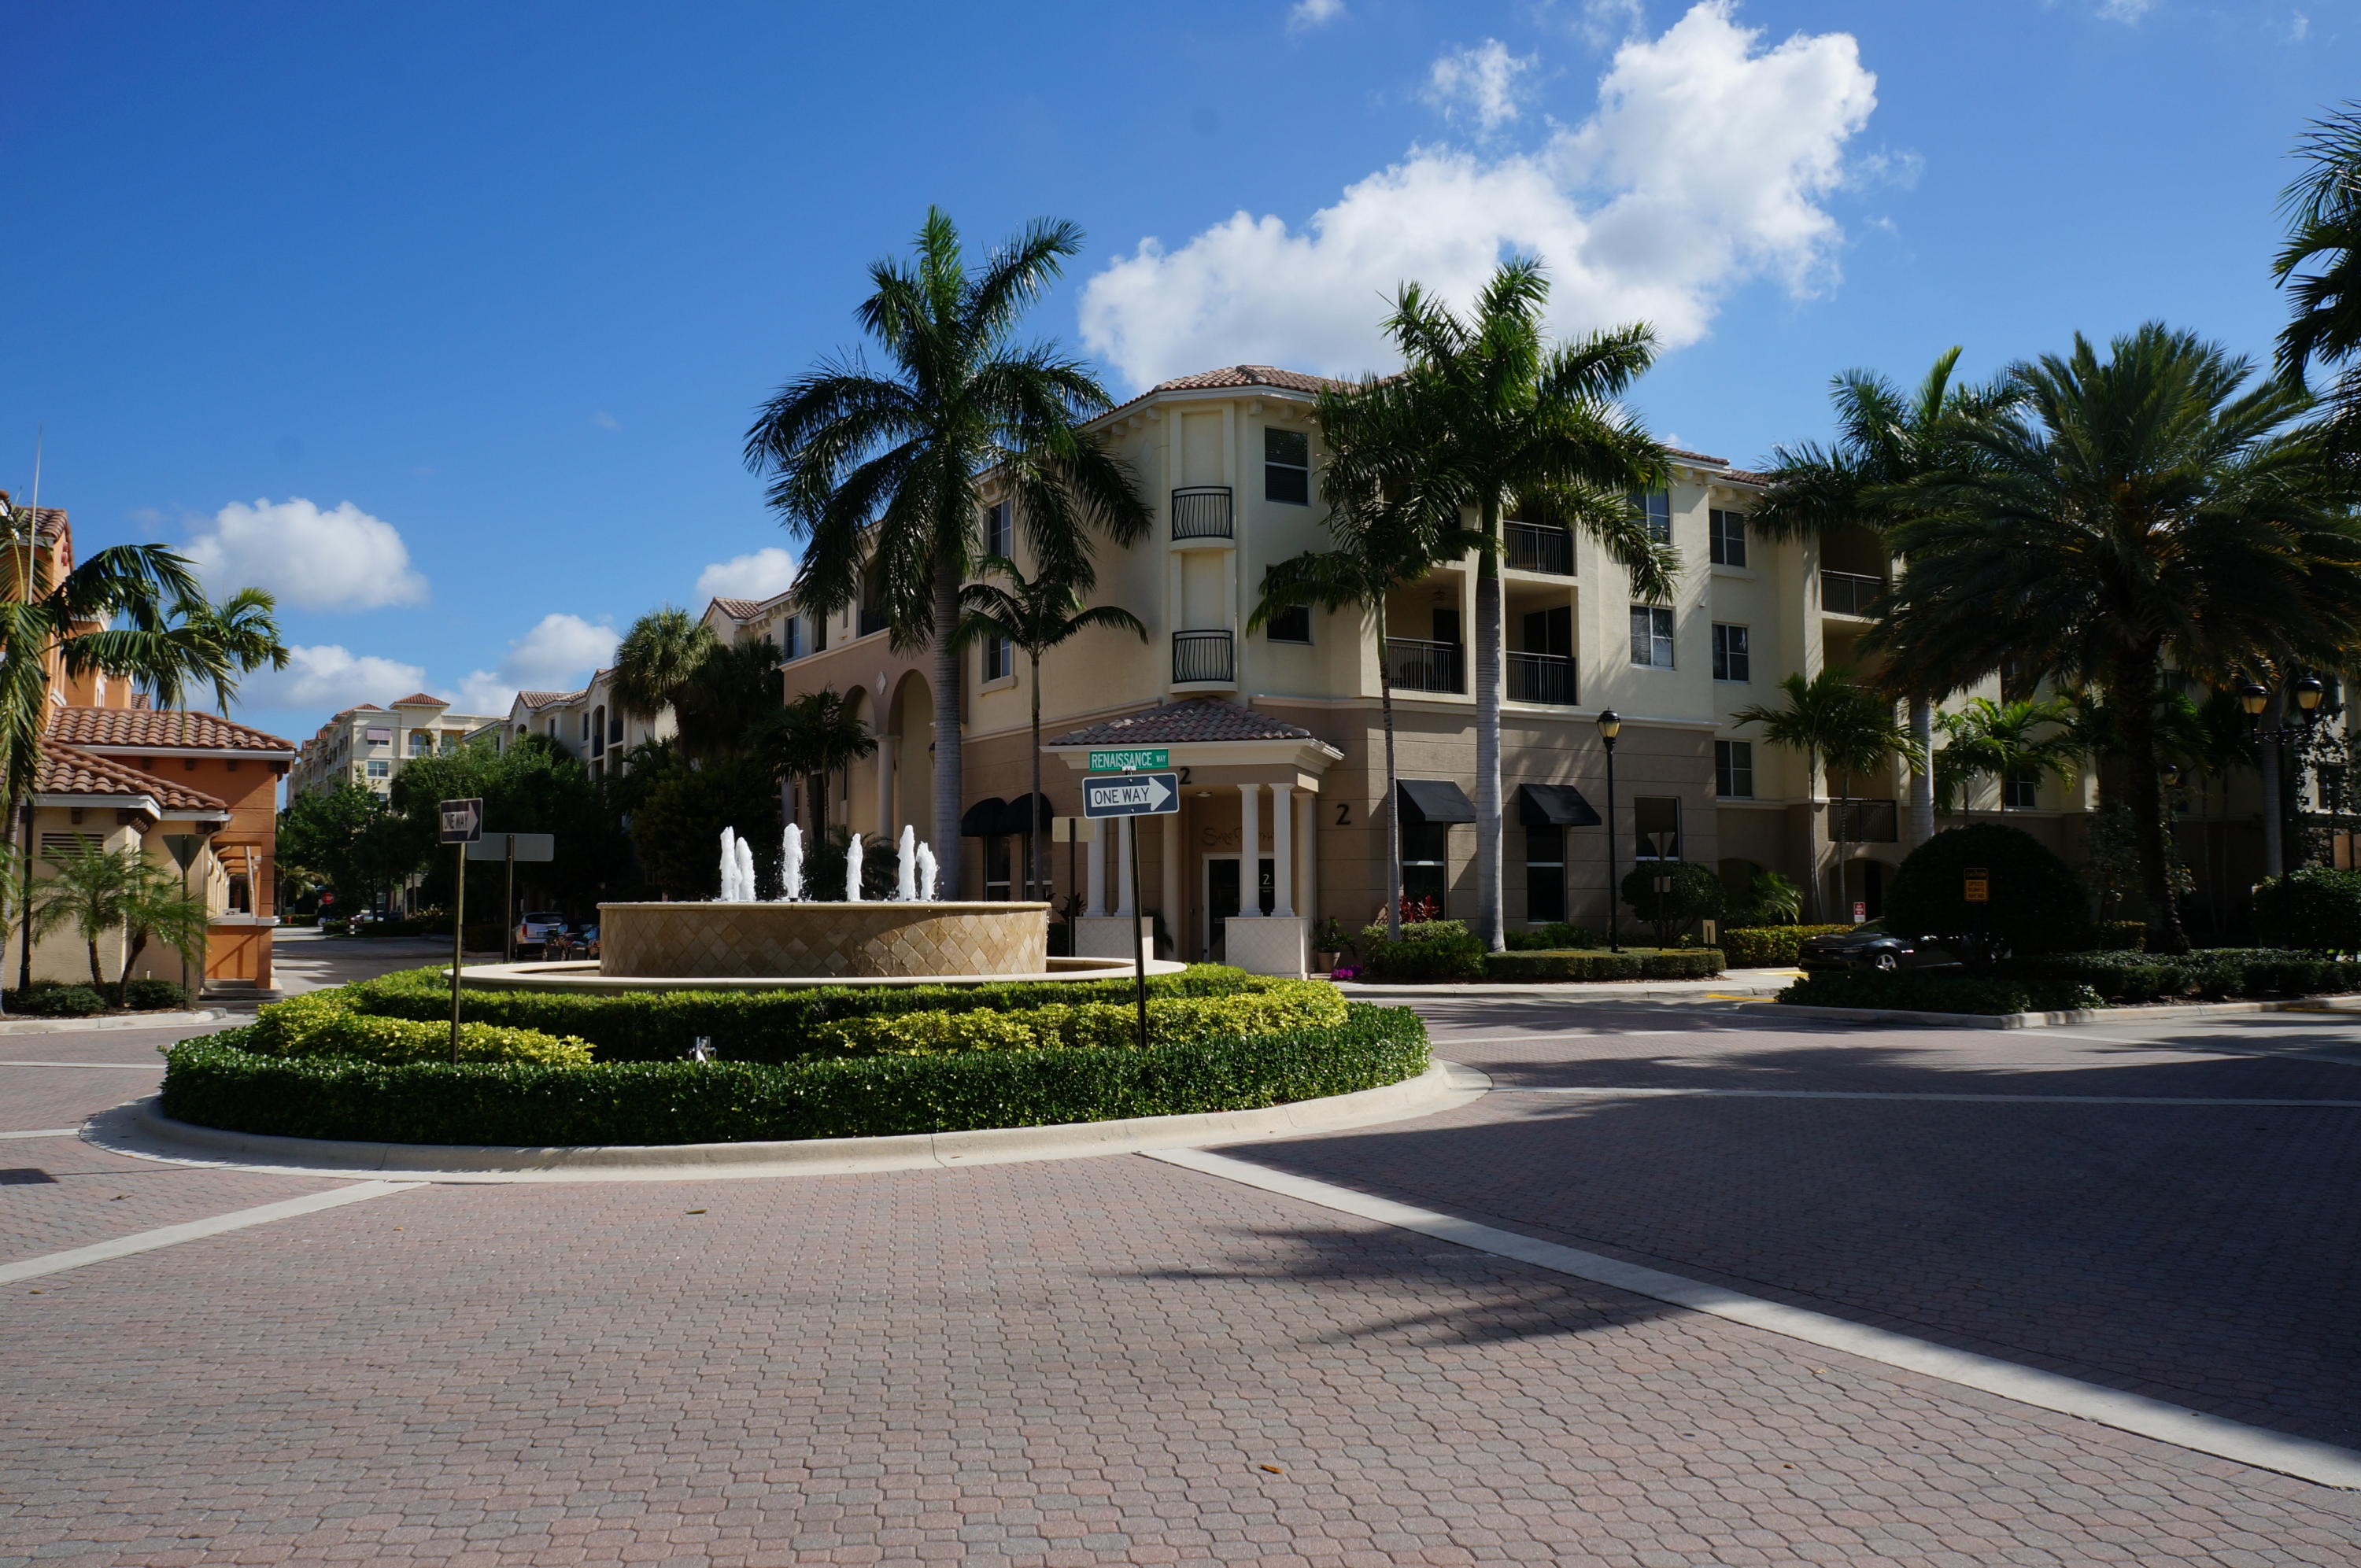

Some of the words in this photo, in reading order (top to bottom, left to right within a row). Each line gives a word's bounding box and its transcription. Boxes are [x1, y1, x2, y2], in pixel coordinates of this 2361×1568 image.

[1092, 752, 1153, 769] RENAISSANCE
[1179, 767, 1192, 784] 2
[1094, 789, 1119, 805] ONE
[1122, 788, 1150, 803] WAY
[444, 814, 455, 829] ONE
[456, 812, 469, 829] WAY
[1336, 804, 1351, 825] 2
[1262, 873, 1271, 885] 2
